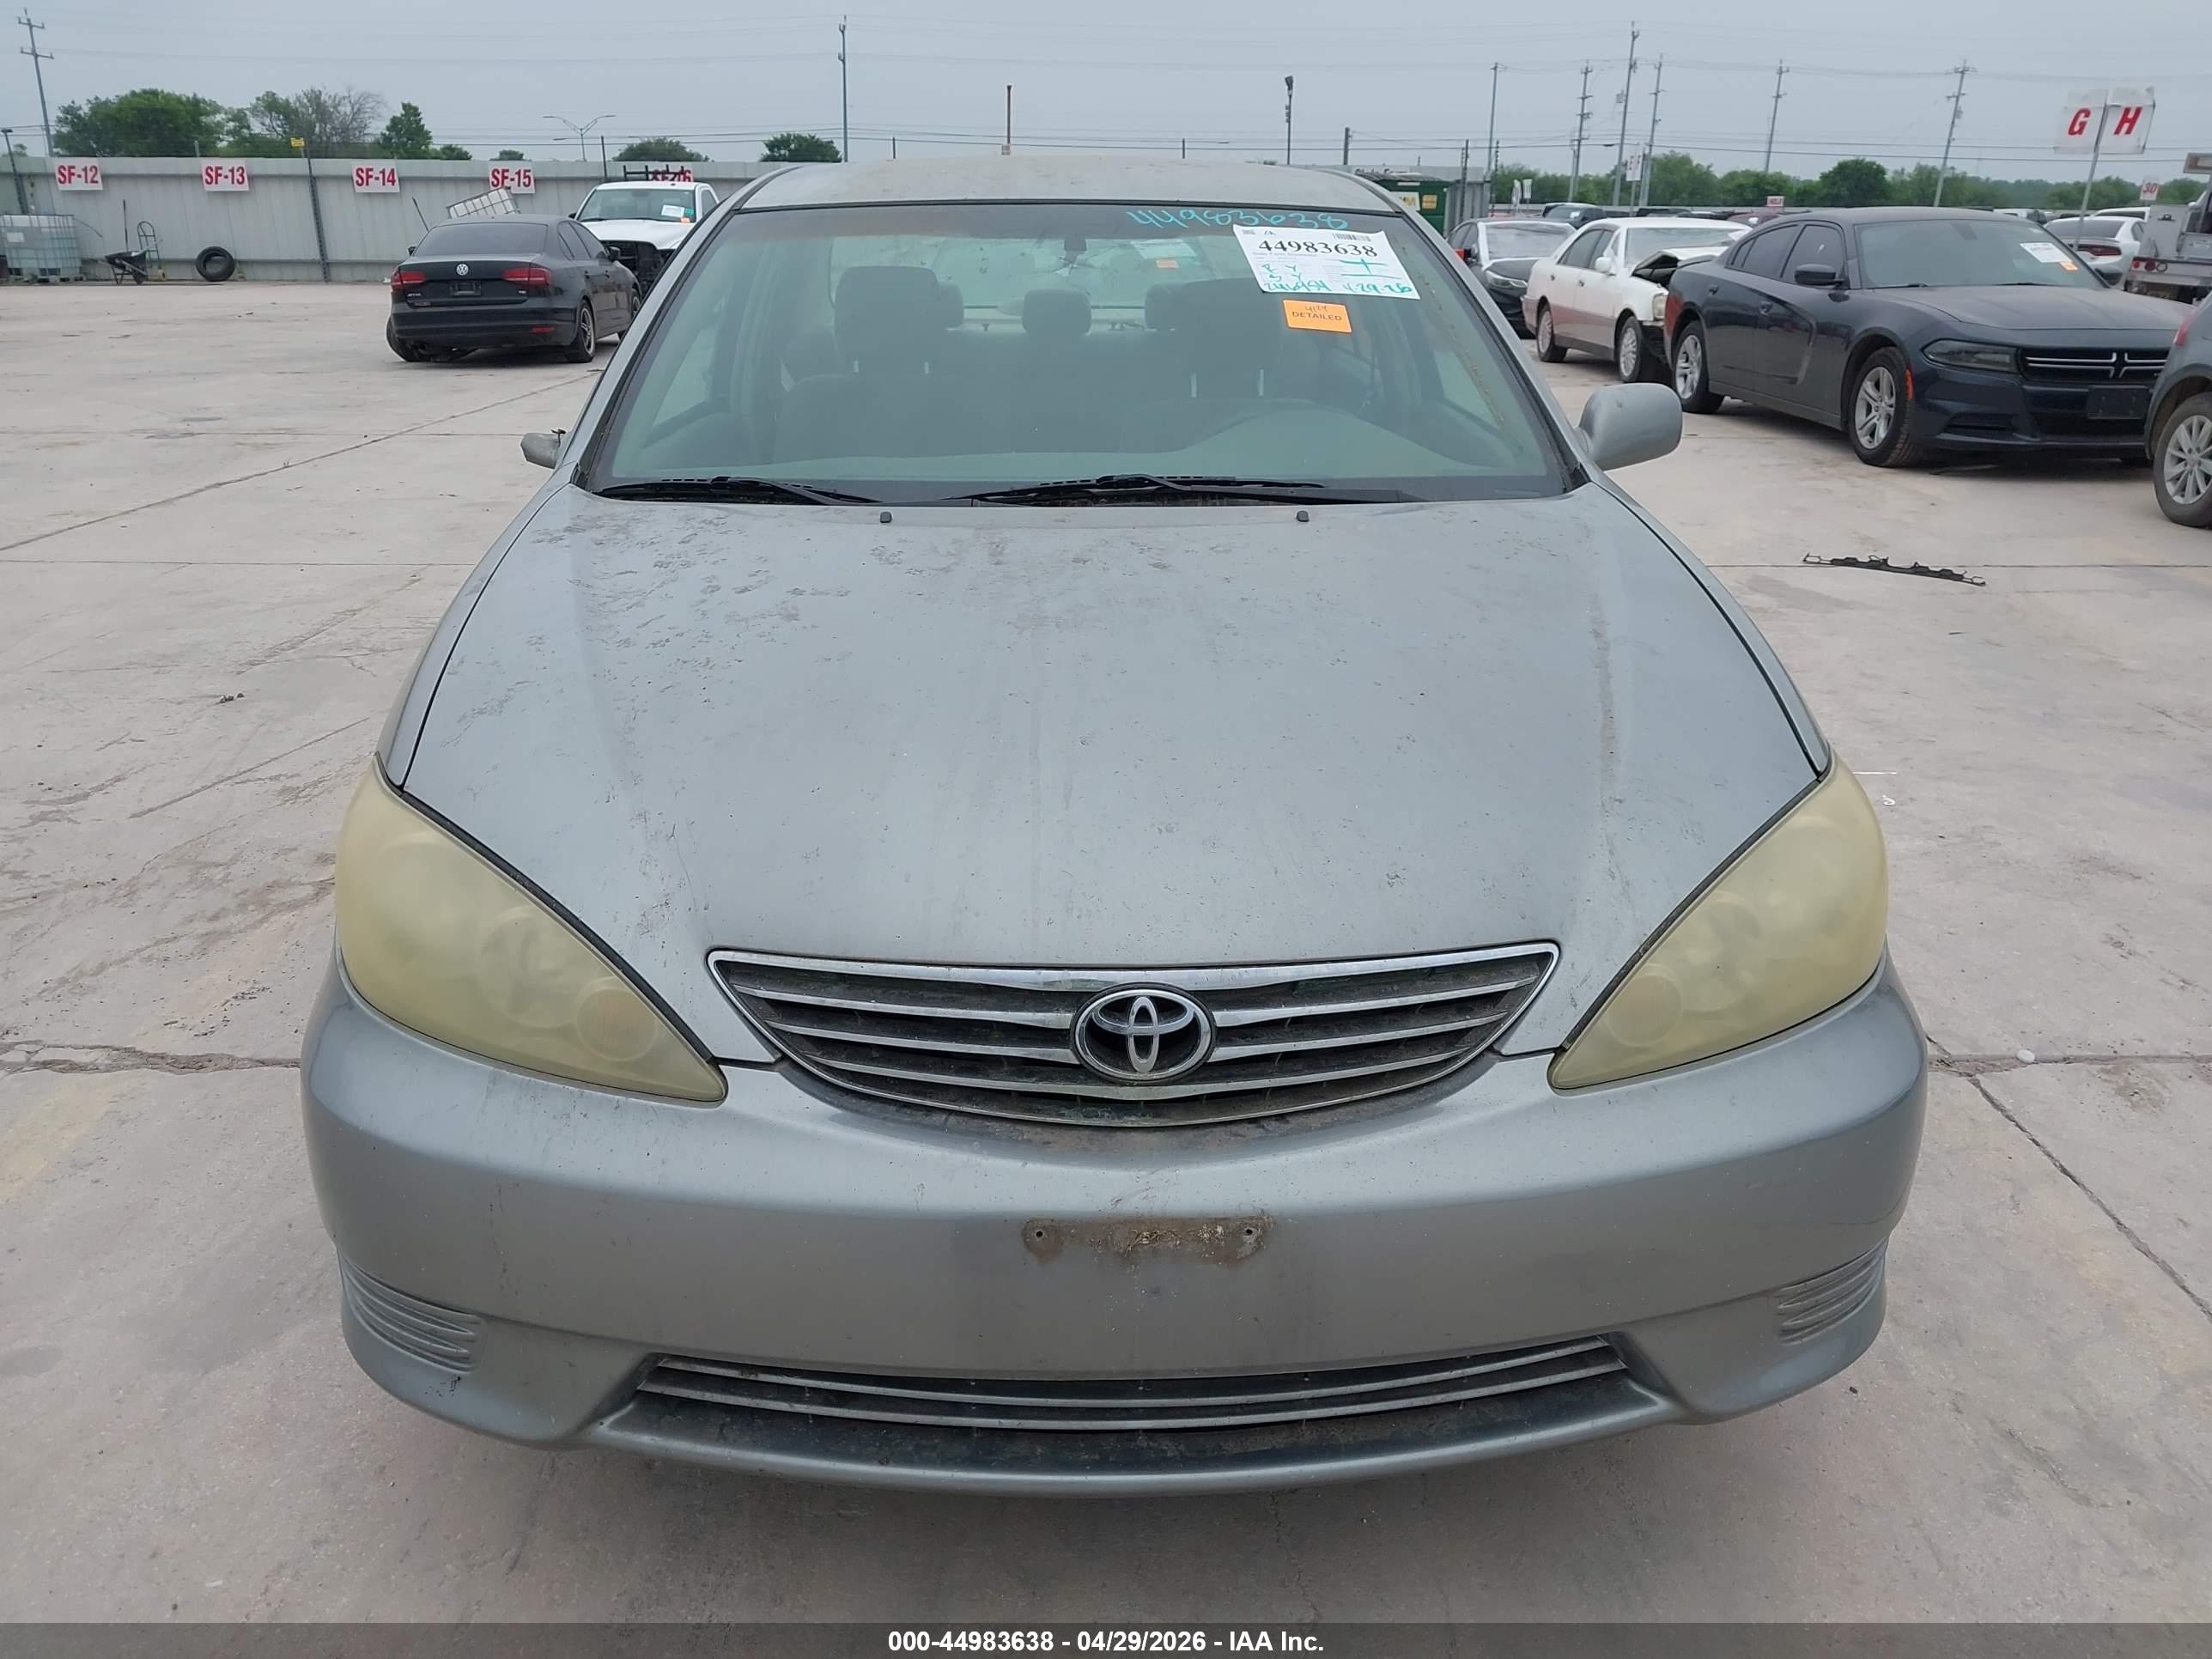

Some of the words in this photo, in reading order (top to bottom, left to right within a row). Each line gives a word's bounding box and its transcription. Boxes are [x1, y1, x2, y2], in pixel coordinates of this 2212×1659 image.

[2068, 106, 2092, 136] G
[2113, 106, 2143, 136] H
[57, 164, 100, 185] SF-12
[204, 165, 246, 185] SF-13
[355, 167, 398, 187] SF-14
[489, 167, 532, 188] SF-15
[1126, 209, 1349, 230] 44983638
[1258, 240, 1379, 258] 44983638
[1291, 311, 1343, 321] DETAILED
